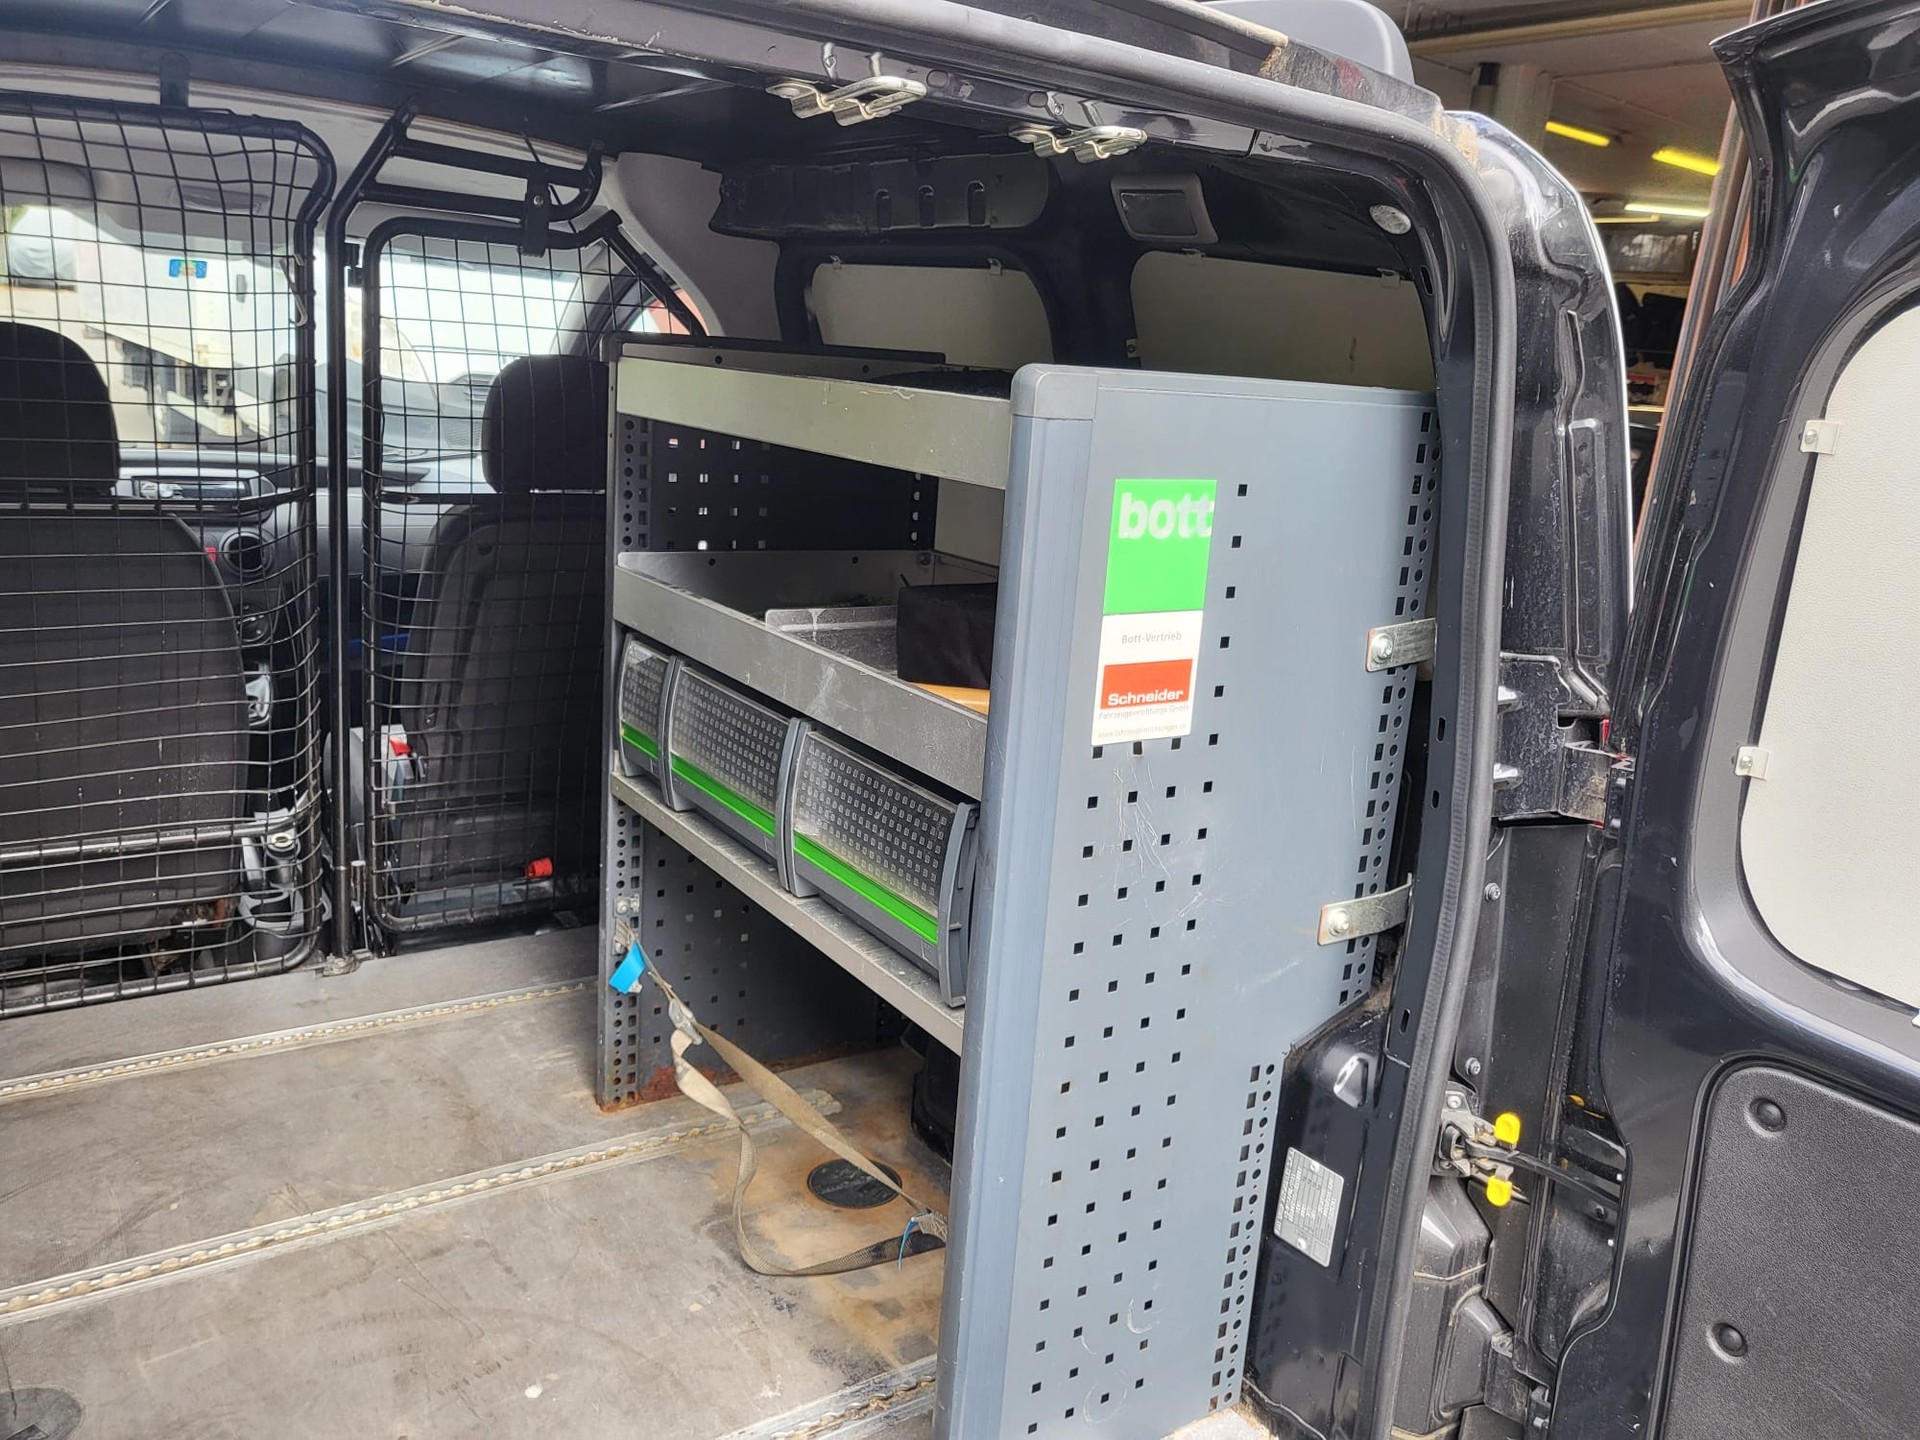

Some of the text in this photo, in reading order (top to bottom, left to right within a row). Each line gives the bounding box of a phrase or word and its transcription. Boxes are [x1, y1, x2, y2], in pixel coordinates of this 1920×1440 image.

[1118, 492, 1214, 540] bott
[1121, 630, 1182, 645] Bott-Vertrieb
[1107, 688, 1184, 706] Schneider
